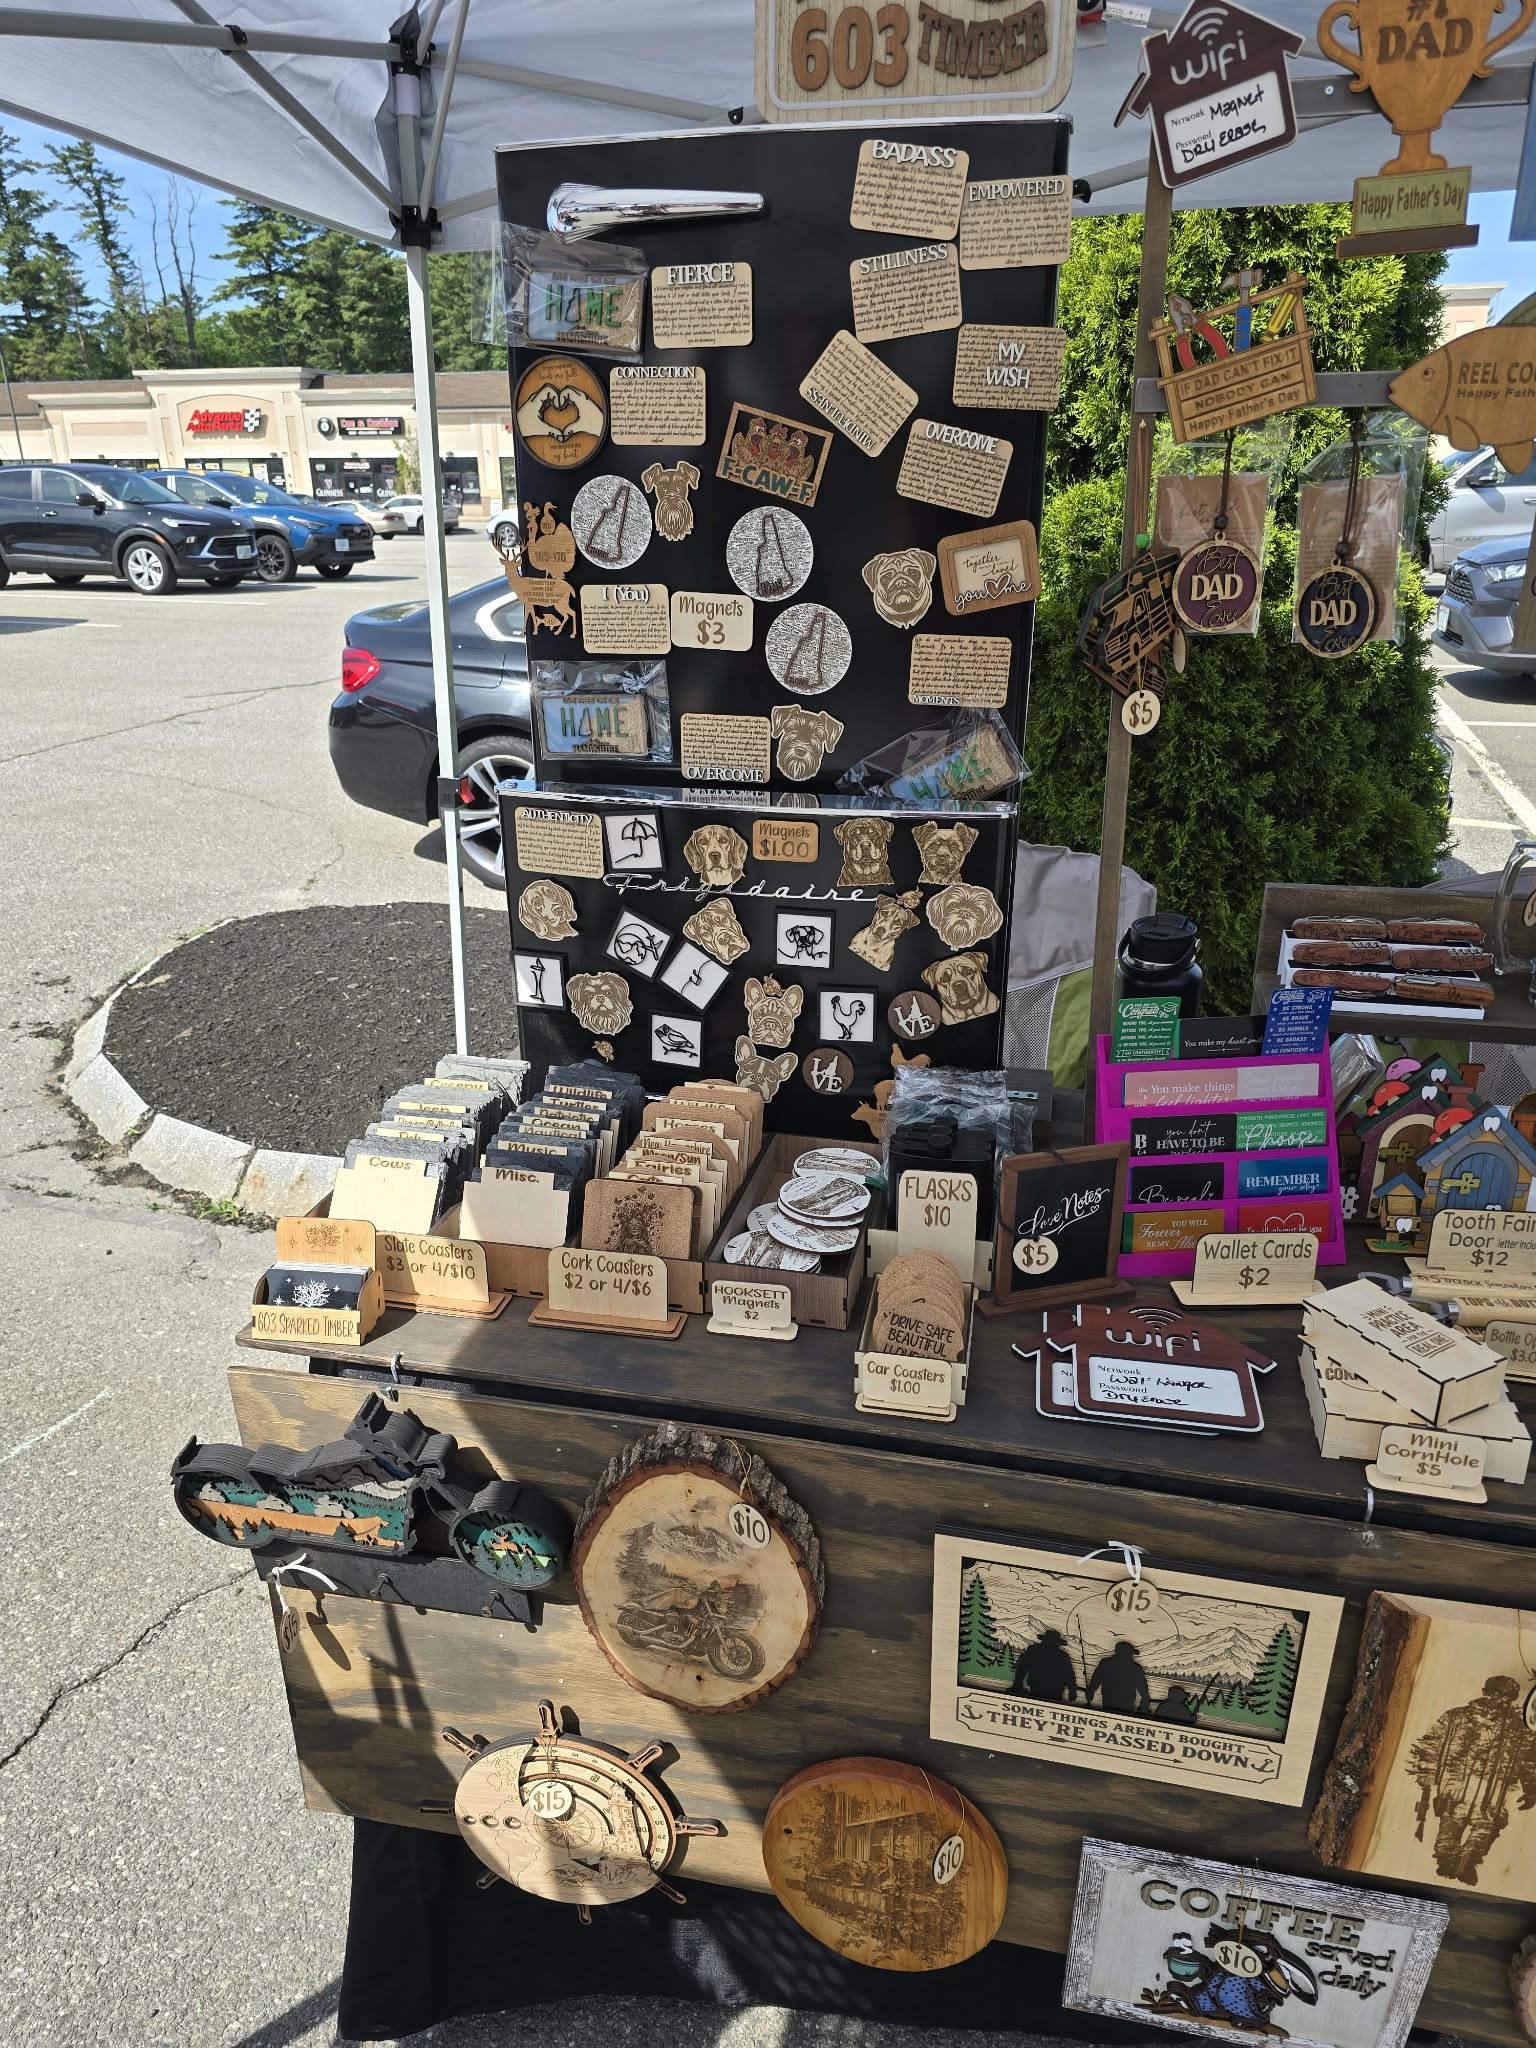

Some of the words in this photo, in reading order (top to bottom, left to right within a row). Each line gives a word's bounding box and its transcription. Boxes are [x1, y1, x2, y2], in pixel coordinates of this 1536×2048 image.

[792, 4, 909, 91] 603
[918, 1, 1048, 79] TIMBER
[1377, 17, 1474, 65] DAD
[872, 140, 957, 169] BADASS
[968, 179, 1065, 202] EMPOWERED
[1359, 189, 1393, 218] Happy
[1397, 183, 1441, 212] Father's
[1442, 181, 1466, 209] Day
[860, 243, 948, 275] STILLNESS
[666, 262, 735, 285] FIERCE
[615, 366, 695, 379] CONNECTION
[986, 367, 1030, 389] WISH
[1194, 374, 1220, 393] DAD
[1263, 355, 1283, 374] FIX
[1458, 361, 1499, 385] REEL
[1507, 361, 1536, 385] CO
[1194, 385, 1255, 411] NOBODY
[1260, 372, 1292, 392] CAN
[1456, 386, 1500, 400] Happy
[189, 409, 243, 423] Advance
[805, 385, 876, 450] MINDFULNESS
[1188, 411, 1224, 435] Happy
[1227, 397, 1275, 423] Father's
[1277, 387, 1301, 411] Day
[185, 421, 212, 432] Auto
[925, 422, 999, 454] OVERCOME
[721, 456, 814, 501] F-CAW-F
[315, 487, 344, 497] GUINNESS
[963, 550, 1001, 574] together
[601, 586, 609, 601] I
[612, 583, 651, 605] (You)
[954, 590, 988, 612] you
[1003, 581, 1032, 594] me
[1190, 573, 1243, 601] DAD
[679, 596, 744, 620] Magnets
[1309, 599, 1357, 626] DAD
[697, 619, 726, 646] $3
[912, 694, 960, 705] MOMENTS
[1129, 700, 1153, 729] $5
[686, 767, 765, 783] OVERCOME
[522, 808, 593, 825] AUTHENTICITY
[759, 822, 810, 840] Magnets
[759, 838, 810, 858] $1.00
[1184, 1039, 1198, 1048] You
[1198, 1038, 1217, 1047] make
[1217, 1038, 1227, 1048] my
[1228, 1036, 1247, 1046] heart
[553, 1085, 607, 1099] Wildlife
[1151, 1084, 1169, 1094] You
[1172, 1083, 1200, 1093] make
[1204, 1081, 1235, 1094] things
[531, 1117, 581, 1130] Ocean
[507, 1142, 557, 1155] Music
[1157, 1139, 1189, 1150] HAVE
[1191, 1137, 1207, 1148] TO
[1210, 1136, 1225, 1147] BE
[1245, 1123, 1318, 1151] Choose
[369, 1156, 412, 1171] Cows
[495, 1168, 540, 1184] Misc.
[1246, 1173, 1320, 1188] REMEMBER
[904, 1176, 973, 1202] FLASKS
[1278, 1185, 1298, 1196] your
[1062, 1187, 1110, 1219] Notes
[924, 1203, 952, 1229] $10
[1171, 1220, 1188, 1228] YOU
[1188, 1219, 1209, 1227] WILL
[1443, 1211, 1496, 1231] Tooth
[1138, 1223, 1182, 1239] Forever
[1449, 1232, 1495, 1249] Door
[1497, 1238, 1519, 1249] letter
[384, 1235, 415, 1254] Slate
[419, 1239, 474, 1262] Coasters
[1022, 1243, 1050, 1268] $5
[1204, 1240, 1257, 1260] Wallet
[1262, 1239, 1312, 1259] Cards
[1469, 1248, 1509, 1267] $12
[386, 1256, 405, 1273] $3
[410, 1261, 426, 1274] or
[432, 1261, 476, 1281] 4/$10
[561, 1251, 593, 1272] Cork
[596, 1254, 654, 1278] Coasters
[564, 1271, 584, 1291] $2
[589, 1278, 608, 1292] or
[612, 1277, 652, 1297] 4/$6
[1238, 1265, 1271, 1290] $2
[714, 1285, 788, 1301] HOOKSETT
[722, 1295, 780, 1310] Magnets
[1459, 1296, 1495, 1308] TOPS
[258, 1312, 277, 1333] 603
[279, 1314, 321, 1335] SPARKED
[322, 1315, 354, 1338] TIMBER
[744, 1310, 760, 1320] $2
[1366, 1307, 1390, 1319] MINI
[1368, 1310, 1415, 1331] PRACTICE
[889, 1312, 925, 1334] DRIVE
[924, 1323, 956, 1344] SAFE
[1390, 1321, 1424, 1338] AREA
[1490, 1328, 1521, 1345] Bottle
[887, 1327, 947, 1358] BEAUTIFUL
[1411, 1341, 1437, 1354] REAL
[1430, 1334, 1450, 1346] ONE
[866, 1360, 889, 1376] Car
[893, 1364, 946, 1384] Coasters
[889, 1377, 921, 1395] $1.00
[1409, 1433, 1460, 1453] Mini
[1383, 1443, 1480, 1470] CornHole
[1415, 1462, 1443, 1477] $5
[732, 1509, 767, 1544] $10
[1110, 1587, 1152, 1614] $15
[1001, 1702, 1045, 1720] SOME
[1048, 1708, 1110, 1730] THINGS
[1112, 1719, 1175, 1741] AREN'T
[1177, 1732, 1246, 1754] BOUGHT
[986, 1711, 1087, 1739] THEY'RE
[1092, 1728, 1176, 1757] PASSED
[1180, 1744, 1251, 1770] DOWN
[533, 1789, 567, 1814] $15
[937, 1841, 964, 1881] $10
[1140, 1879, 1366, 1948] COFFEE
[1218, 1944, 1258, 1974] $10
[1304, 1940, 1397, 1975] served
[1317, 1964, 1387, 2000] daily
